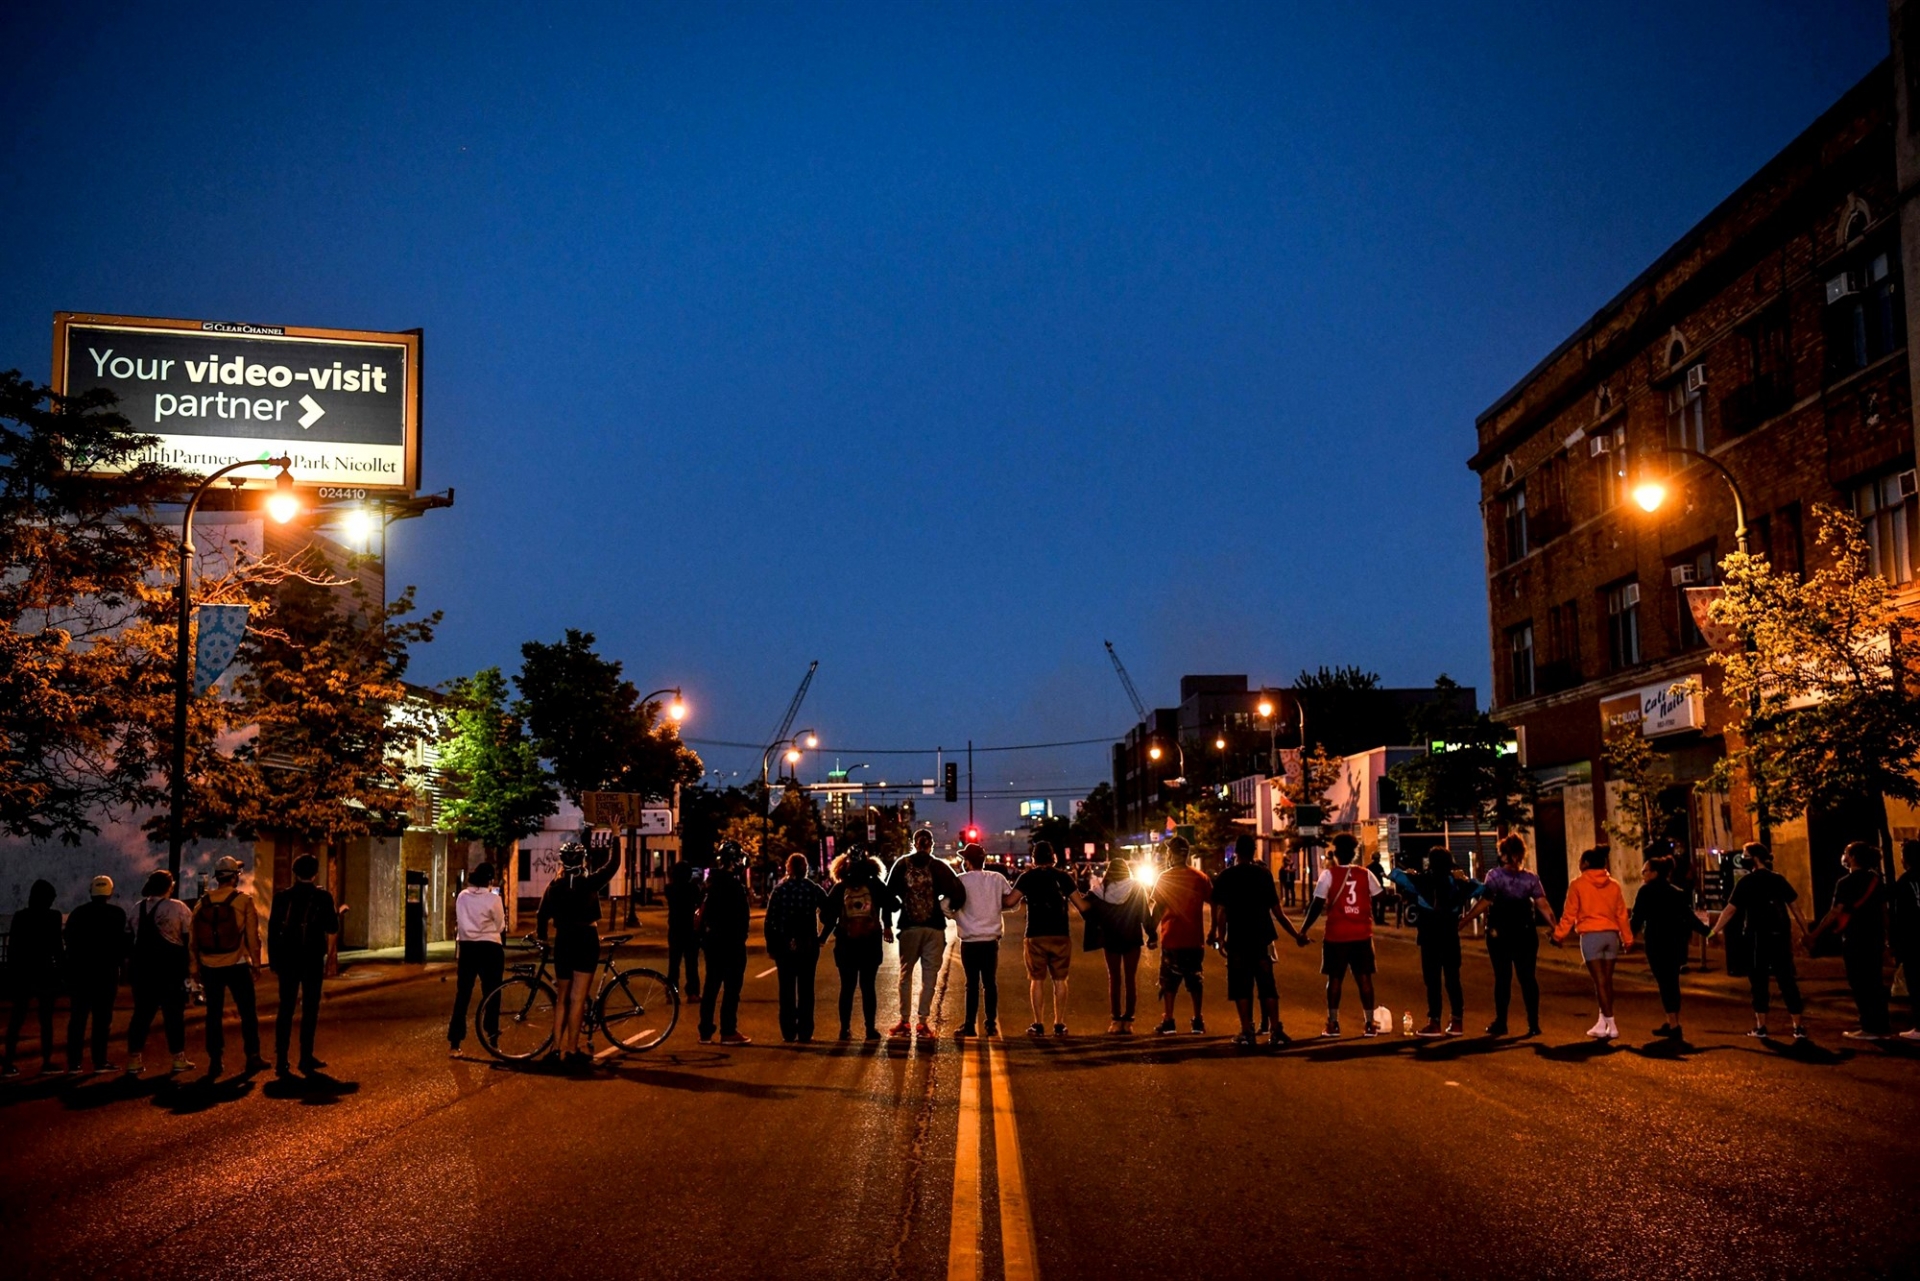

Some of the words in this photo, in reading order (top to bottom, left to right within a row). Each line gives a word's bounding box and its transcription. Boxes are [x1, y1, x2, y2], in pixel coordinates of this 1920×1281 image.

[88, 347, 175, 381] Your
[184, 354, 387, 393] video-visit
[154, 391, 289, 423] partner
[118, 446, 241, 466] ealthPartners
[294, 453, 330, 470] Park
[335, 456, 397, 473] Nicollet
[319, 487, 367, 500] 024410
[1644, 689, 1666, 714] Cali
[1660, 691, 1685, 719] Nails
[1346, 880, 1358, 905] 3
